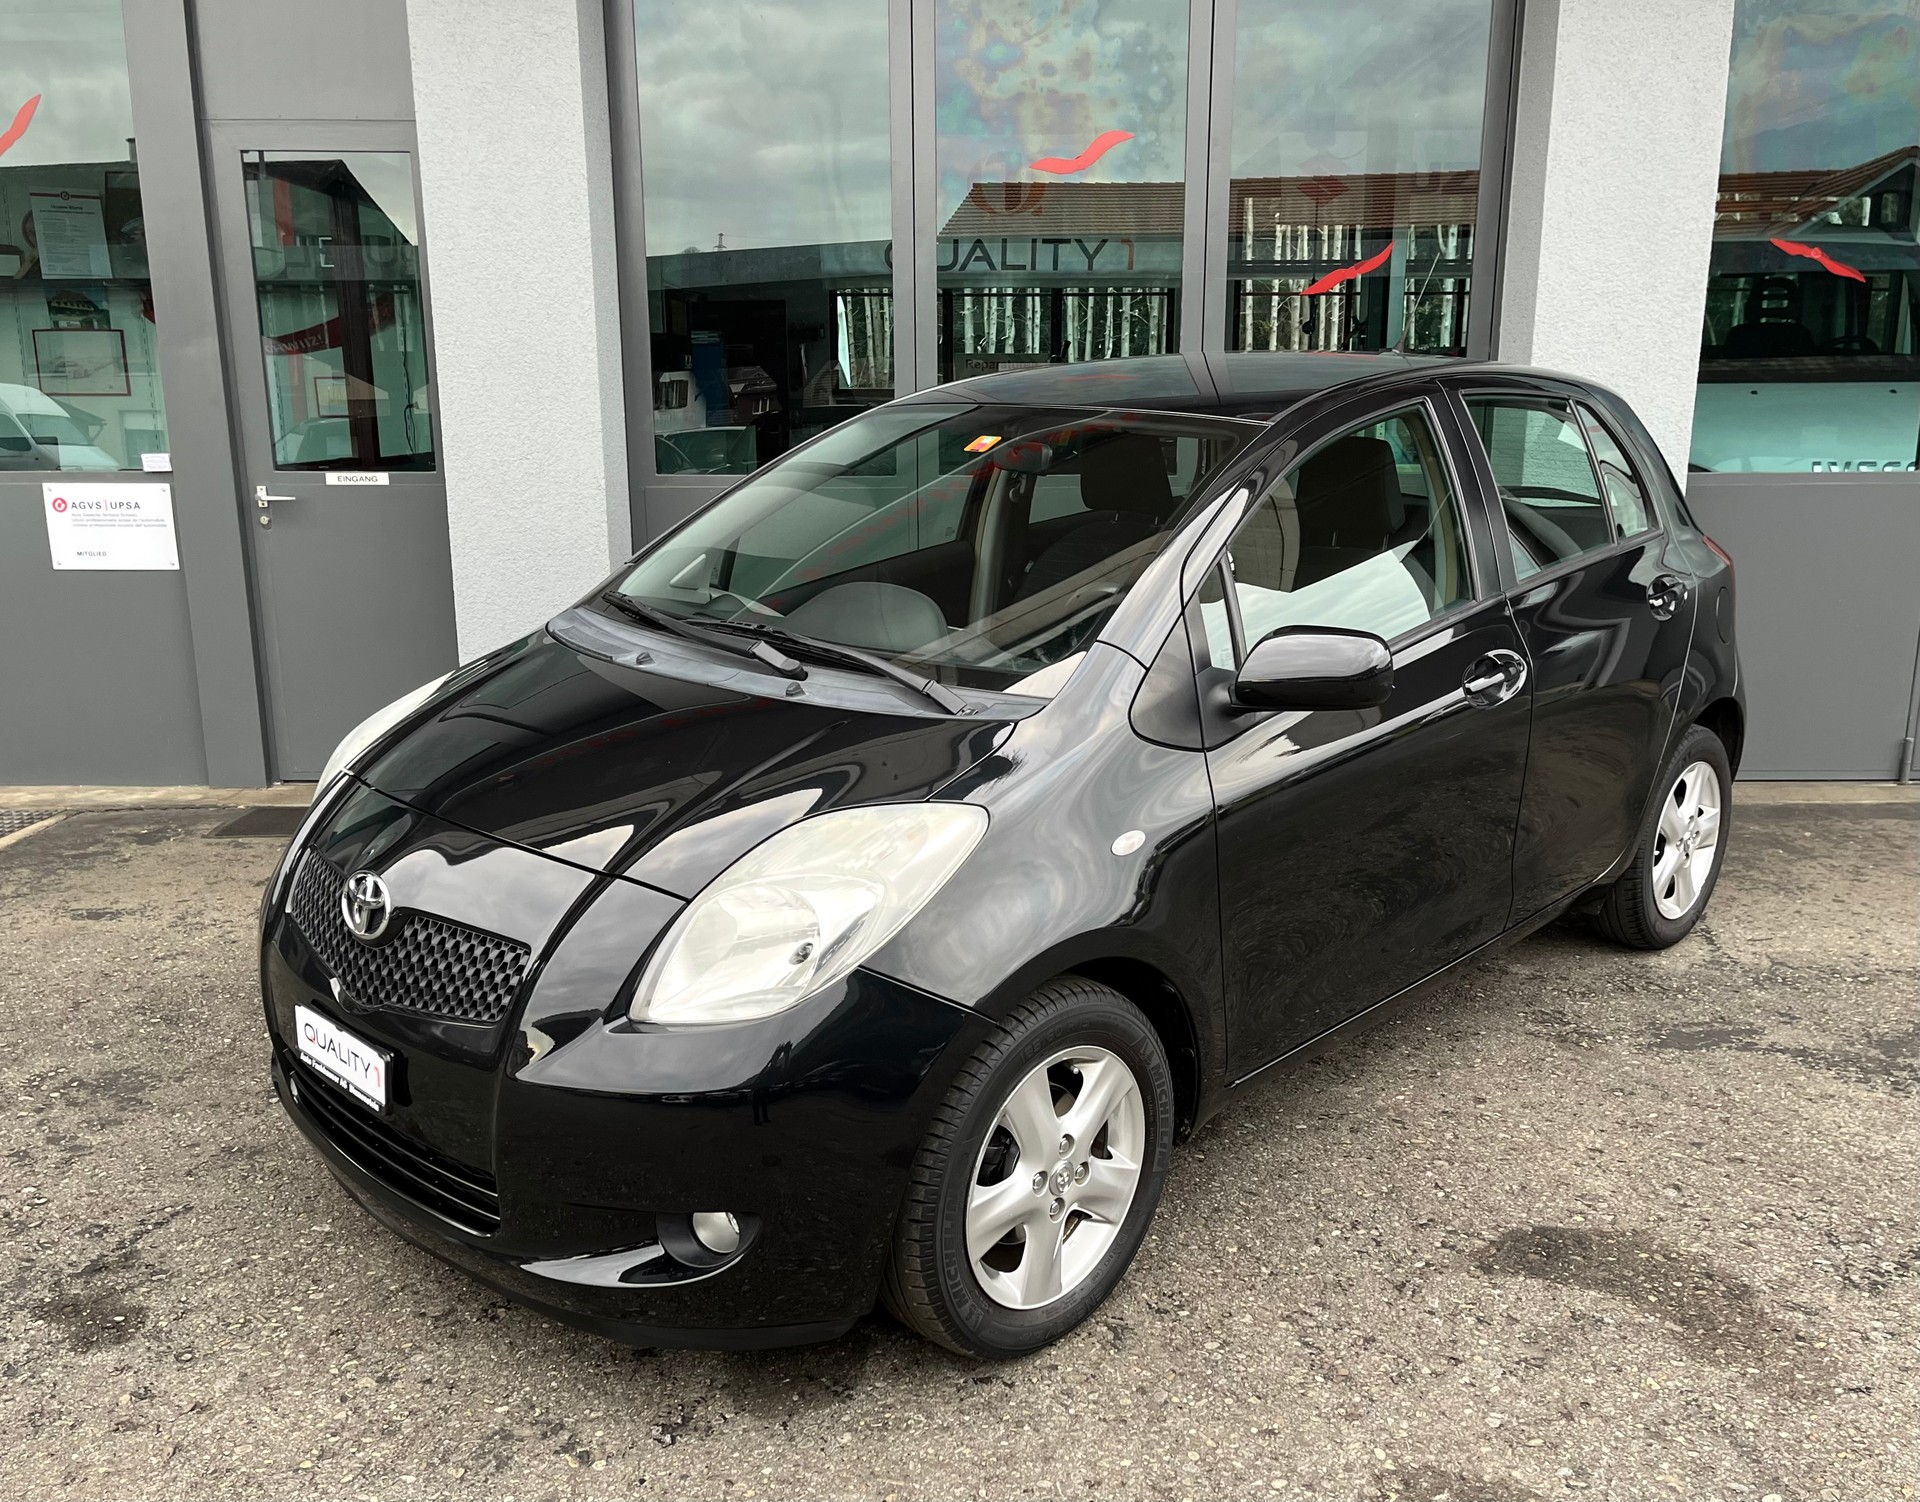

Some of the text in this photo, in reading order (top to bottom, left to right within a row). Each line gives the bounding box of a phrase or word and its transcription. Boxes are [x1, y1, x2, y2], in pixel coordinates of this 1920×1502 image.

[884, 238, 1109, 271] UALITY
[337, 475, 379, 483] EINGANG
[1811, 460, 1915, 473] IVEC
[303, 1022, 370, 1079] QUALITY
[374, 1065, 381, 1088] 1
[1150, 1060, 1170, 1169] MICHELIN
